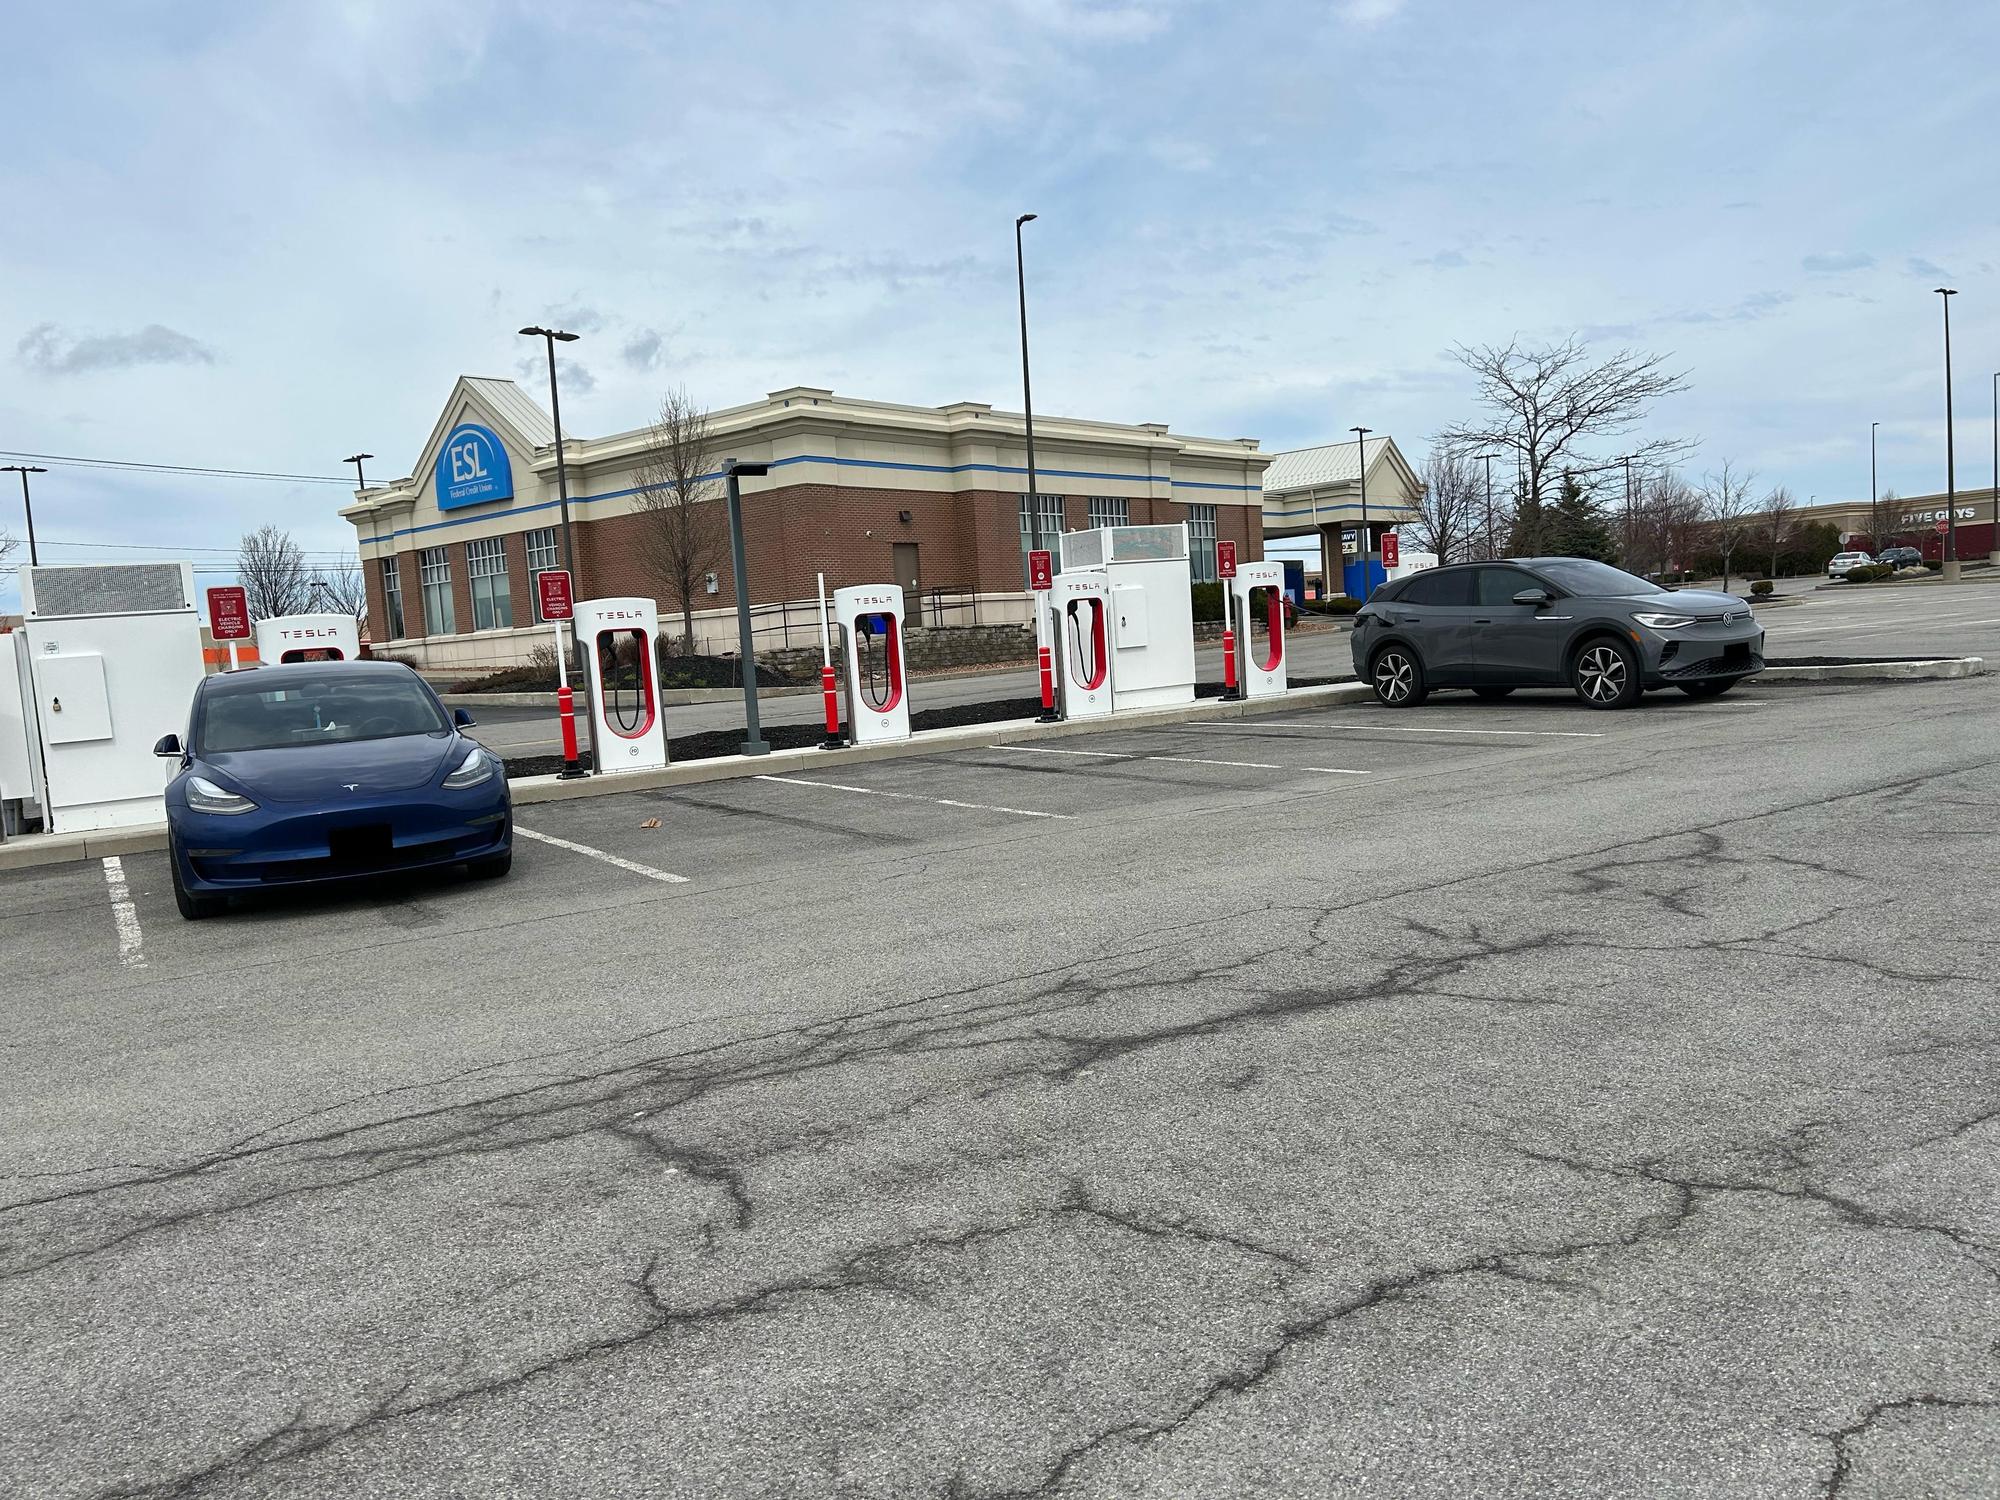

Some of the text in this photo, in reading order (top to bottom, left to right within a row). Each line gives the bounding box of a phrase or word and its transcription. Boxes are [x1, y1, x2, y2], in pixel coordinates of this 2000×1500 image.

[450, 442, 487, 483] ESL
[1901, 511, 1933, 524] FIVE
[1249, 571, 1278, 579] TESLA
[1067, 582, 1100, 591] TESLA
[854, 596, 892, 605] TESLA
[596, 610, 642, 620] TESLA
[280, 628, 337, 639] TESLA
